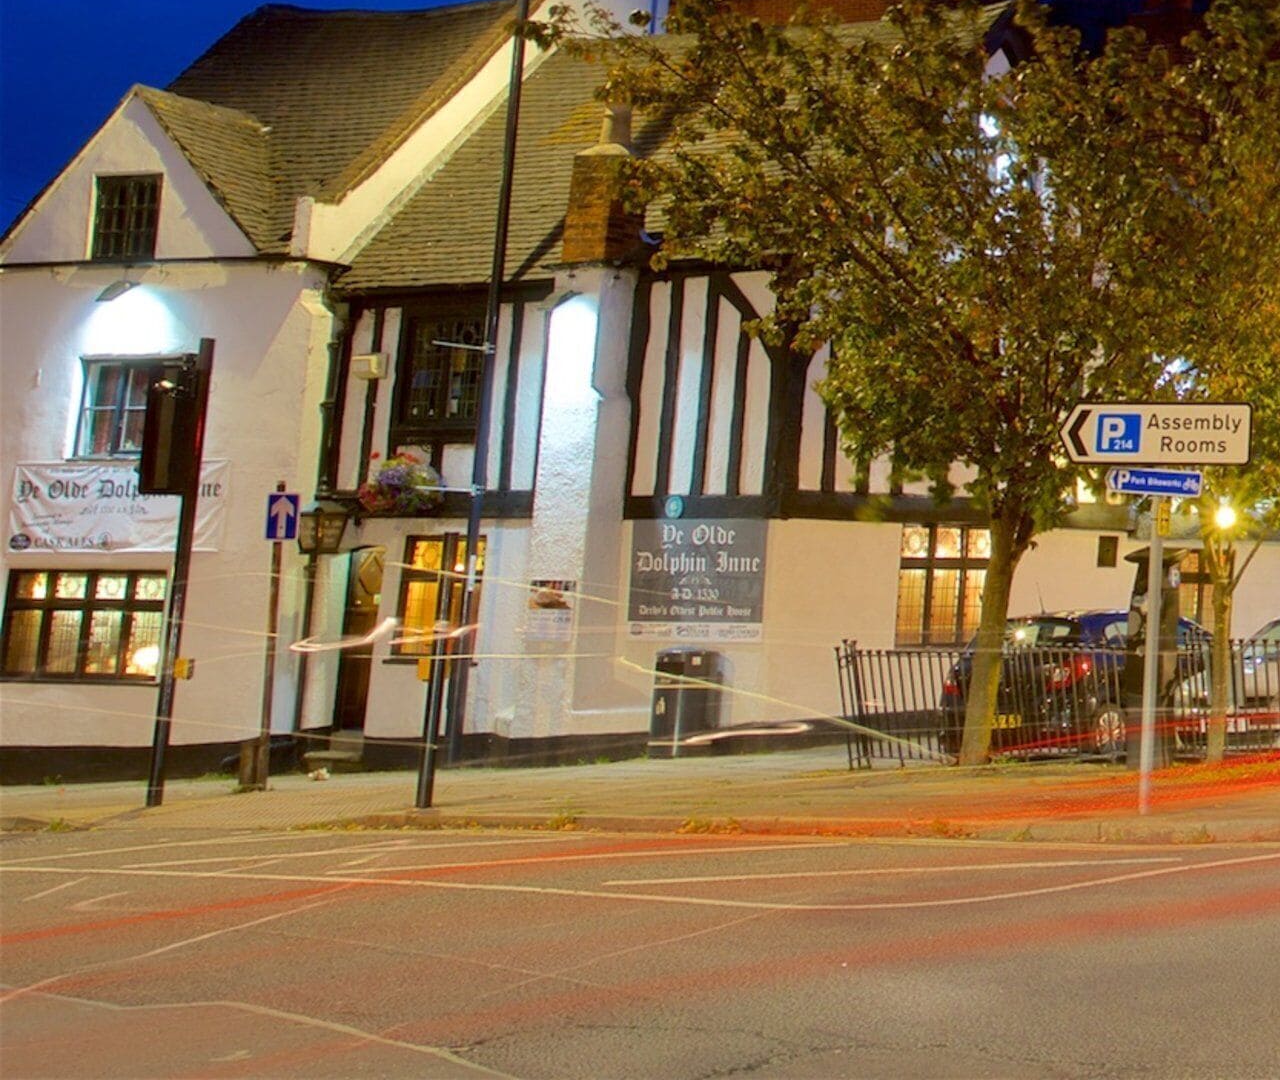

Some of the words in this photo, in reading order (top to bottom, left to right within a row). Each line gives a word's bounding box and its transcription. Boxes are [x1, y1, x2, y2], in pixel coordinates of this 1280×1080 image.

[1101, 417, 1126, 450] P
[1147, 414, 1242, 434] Assembly
[1113, 439, 1134, 450] 214
[1160, 436, 1228, 454] Rooms
[18, 480, 40, 502] Ye
[49, 480, 88, 499] Olde
[662, 524, 684, 549] Ye
[692, 524, 736, 545] Olde
[637, 551, 706, 575] Dolphin
[715, 551, 760, 573] Inne
